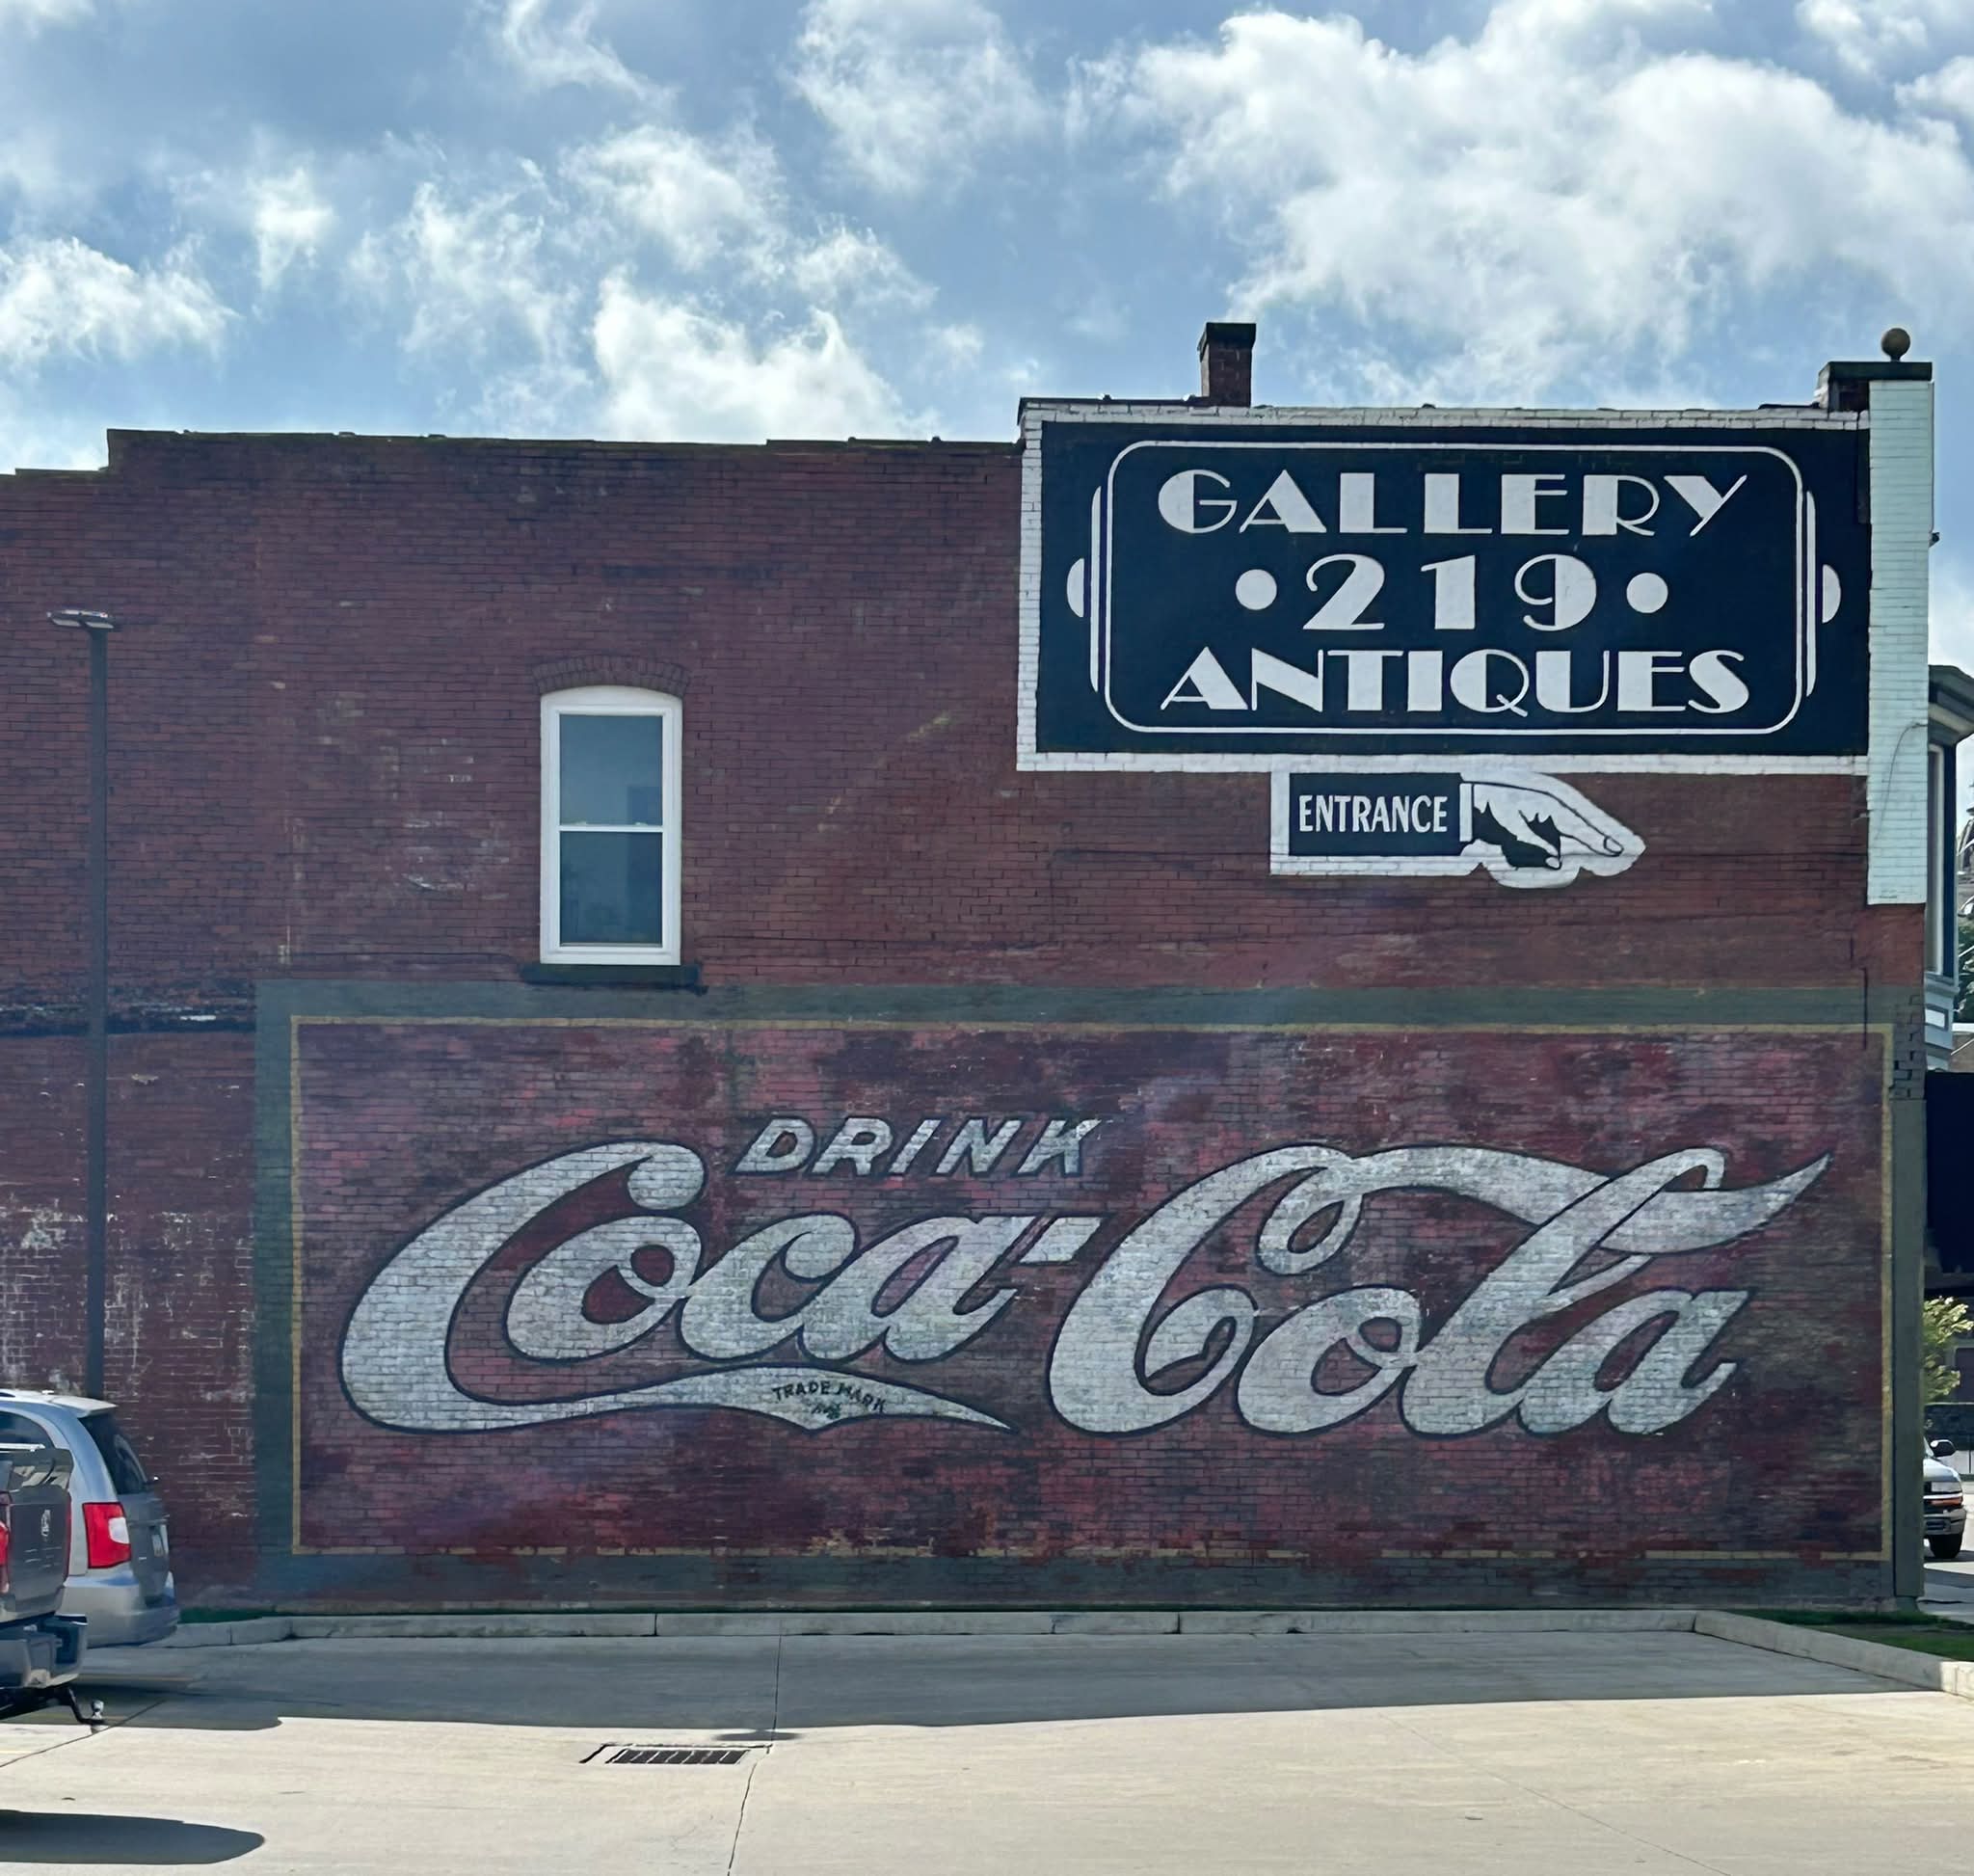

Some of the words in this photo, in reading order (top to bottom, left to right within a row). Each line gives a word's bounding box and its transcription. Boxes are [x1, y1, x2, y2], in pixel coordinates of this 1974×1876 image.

[1157, 469, 1747, 537] GALLERY
[1160, 646, 1749, 717] ANTIQUES
[1298, 794, 1448, 833] ENTRANCE
[735, 1118, 1102, 1175] DRINK
[772, 1380, 830, 1402] TRADE
[835, 1382, 888, 1413] MARK
